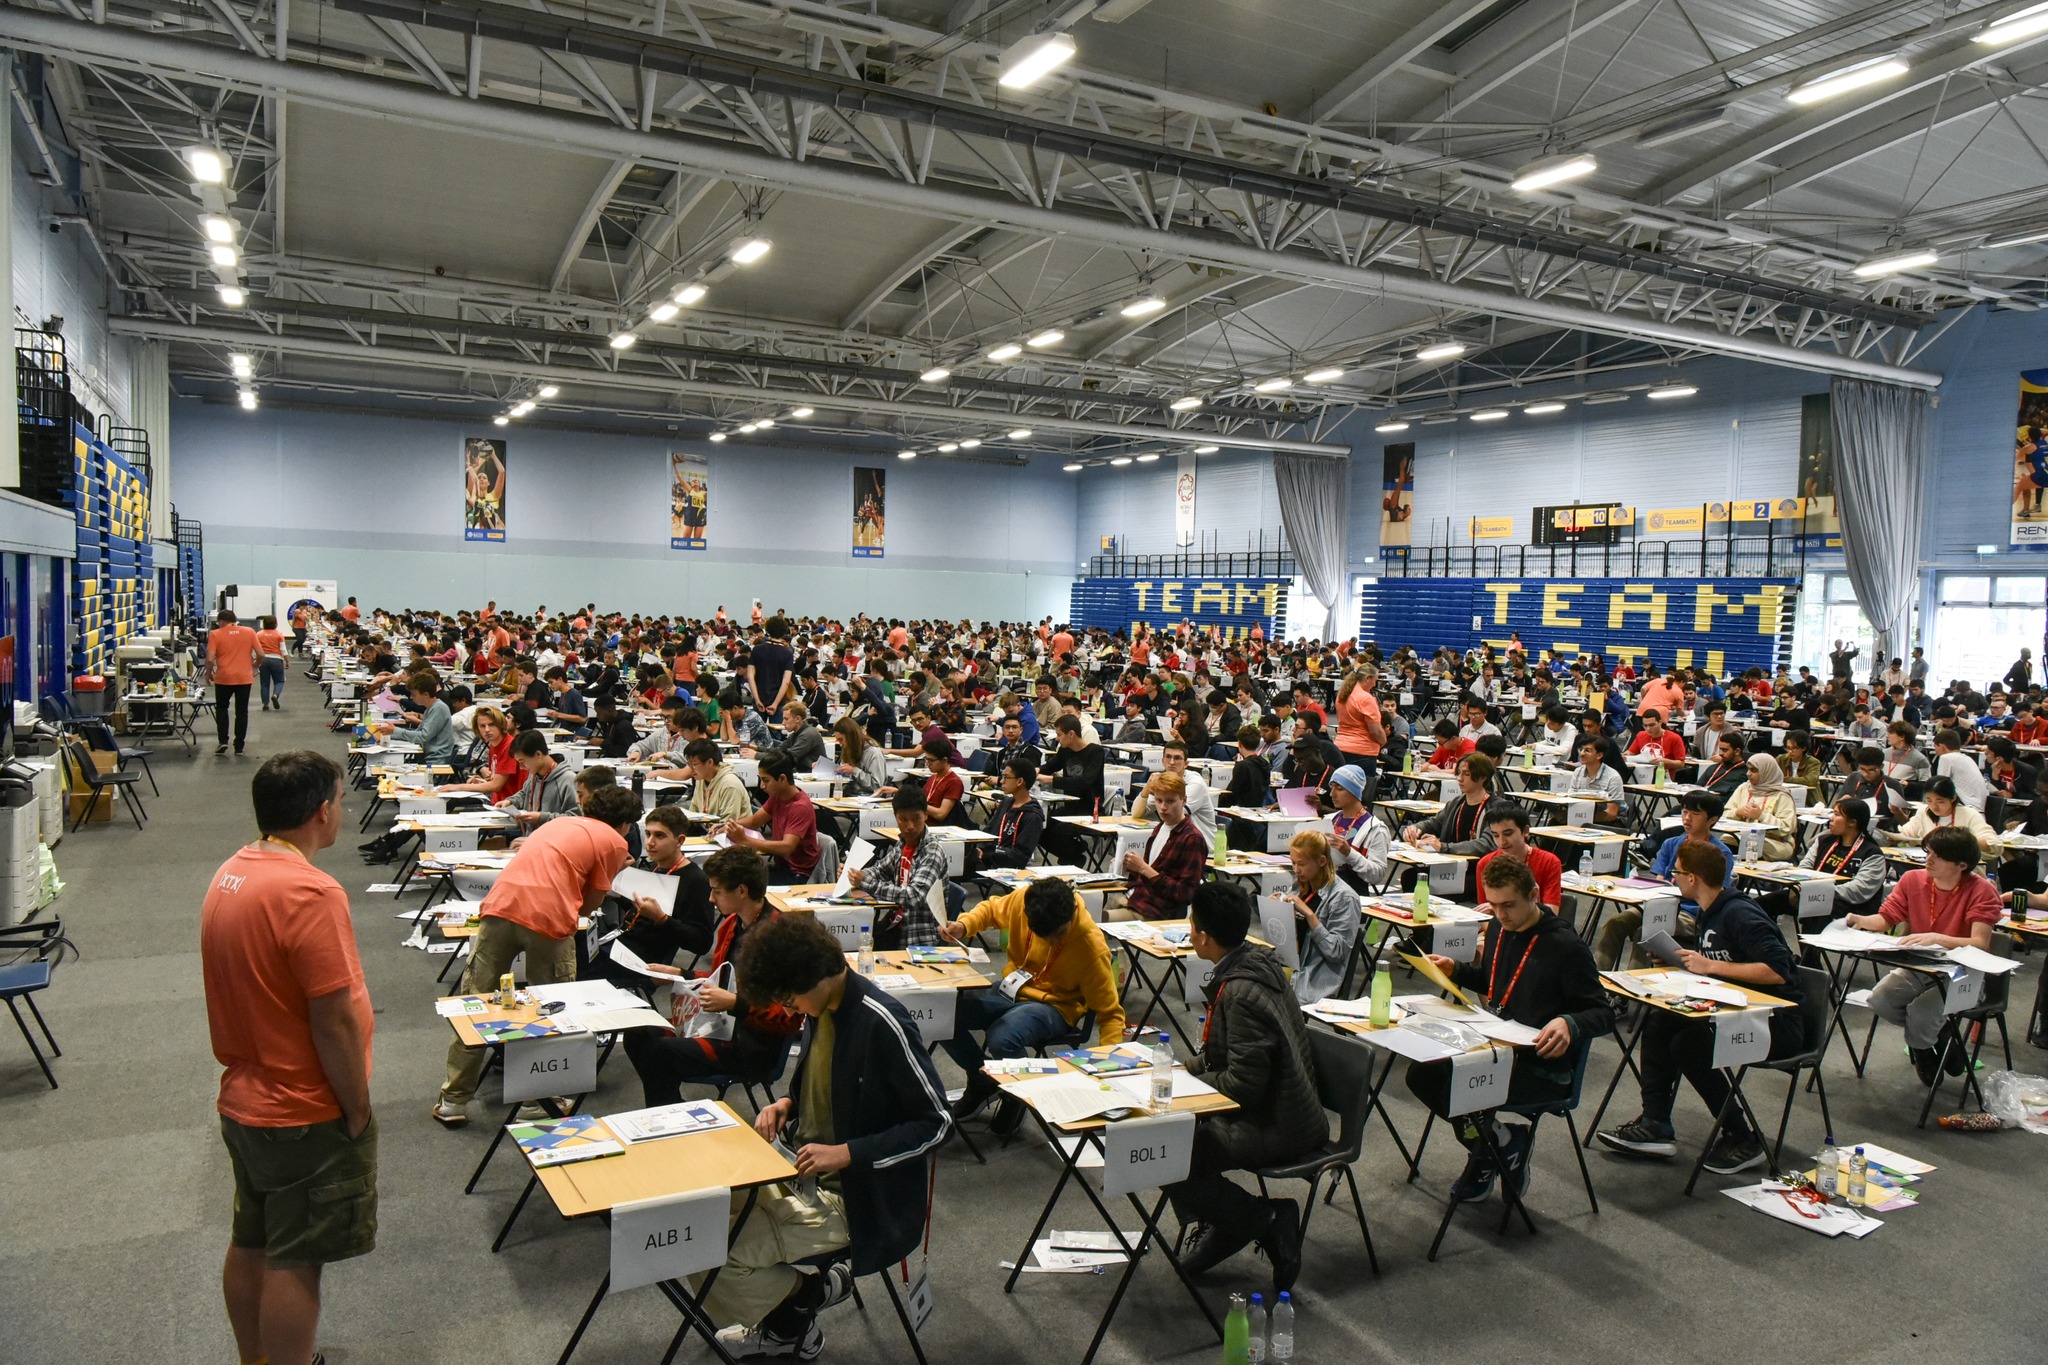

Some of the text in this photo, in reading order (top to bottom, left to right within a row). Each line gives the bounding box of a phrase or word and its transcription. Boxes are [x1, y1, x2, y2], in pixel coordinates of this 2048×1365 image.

[1757, 504, 1766, 517] 2
[1594, 511, 1605, 523] 10
[1134, 582, 1277, 616] TEAM
[1485, 583, 1784, 634] TEAM
[949, 855, 953, 863] 1
[1438, 873, 1450, 881] KAZ
[1272, 885, 1288, 893] HND
[1651, 915, 1662, 923] JPN
[830, 924, 856, 934] BTN 1
[1443, 937, 1464, 948] HKG 1
[516, 952, 521, 962] 1
[909, 1008, 933, 1020] RA 1
[1730, 1032, 1753, 1045] HEL 1
[529, 1058, 569, 1074] ALG 1
[1467, 1073, 1492, 1089] CYP 1
[1128, 1145, 1165, 1163] BOL 1
[643, 1225, 692, 1251] ALB 1
